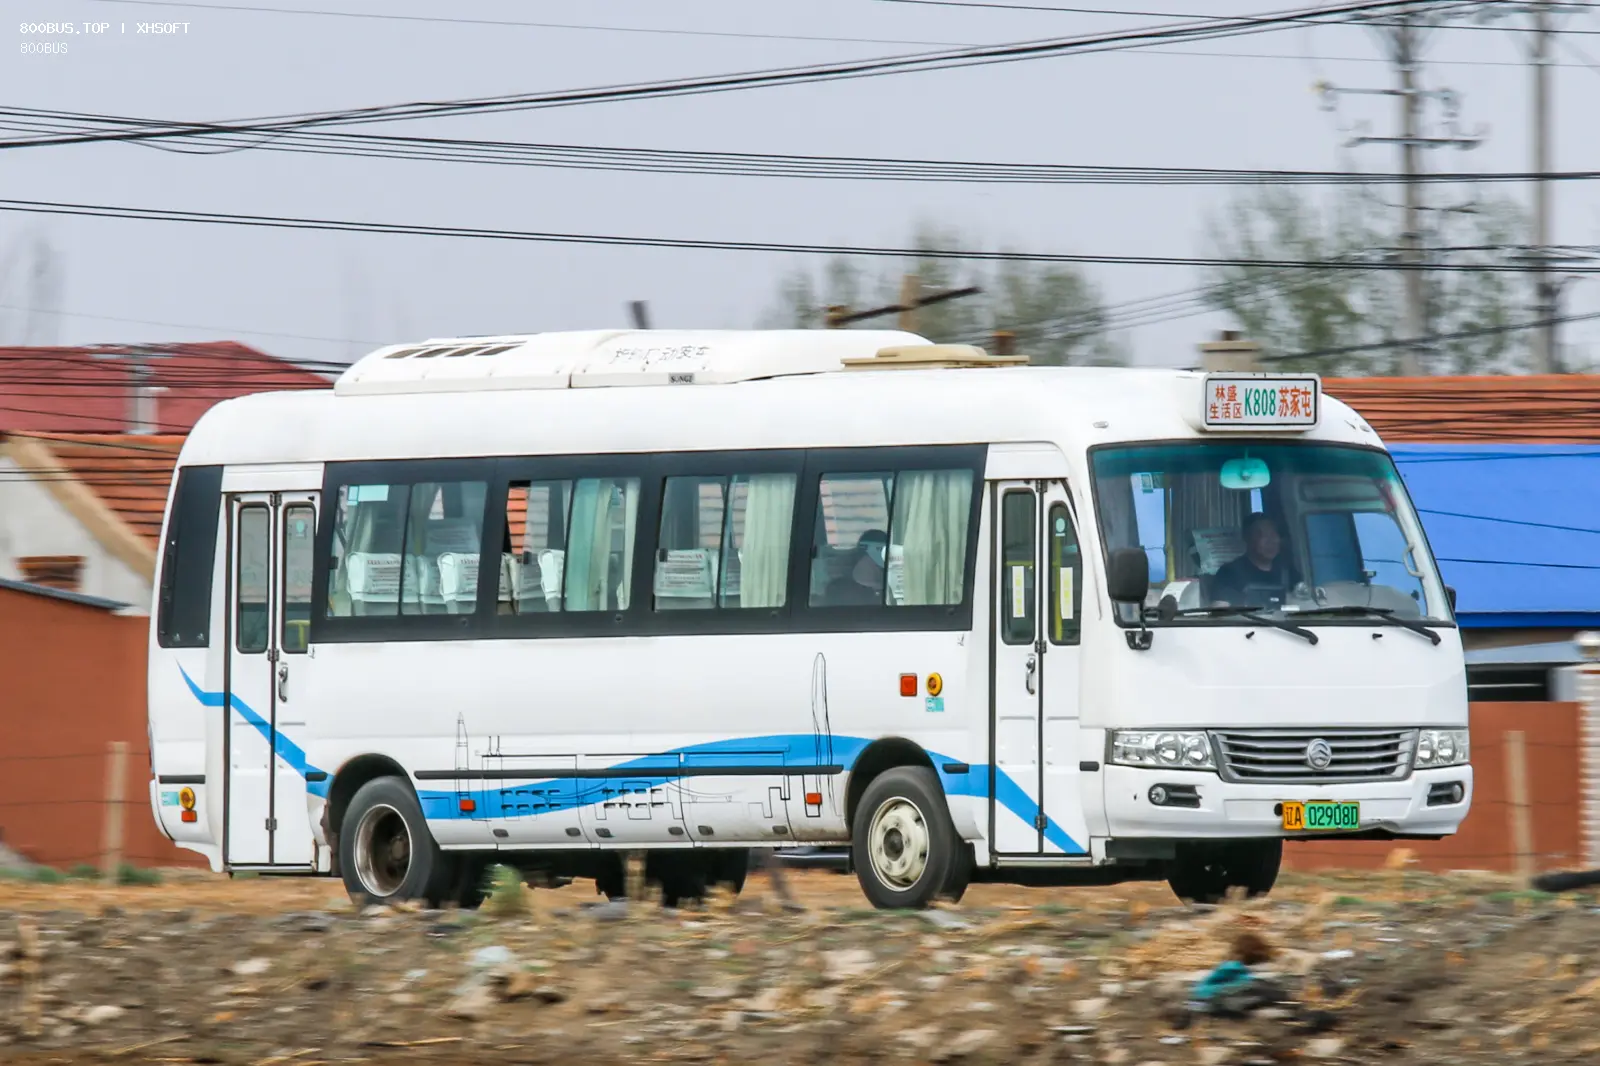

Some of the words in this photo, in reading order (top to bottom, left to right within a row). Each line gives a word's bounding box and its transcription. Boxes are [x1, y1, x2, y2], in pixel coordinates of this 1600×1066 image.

[1215, 384, 1237, 402] 林盛
[1245, 388, 1276, 416] K808
[1278, 386, 1312, 417] 苏家屯
[1209, 402, 1242, 419] 生活区
